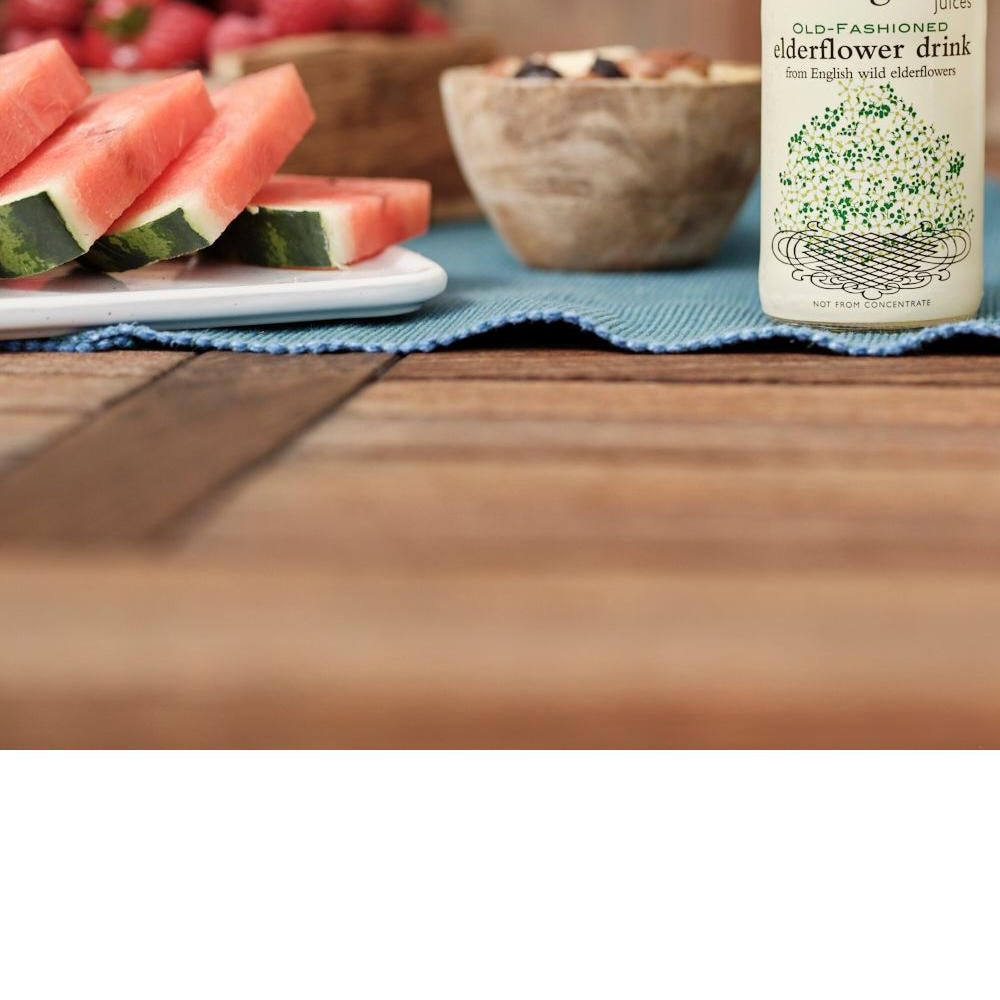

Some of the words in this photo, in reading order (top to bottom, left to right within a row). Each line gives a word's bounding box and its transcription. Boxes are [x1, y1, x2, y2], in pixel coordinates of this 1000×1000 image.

[792, 22, 949, 35] OLD-FASHIONED
[773, 37, 905, 60] elderflower
[916, 34, 972, 59] drink
[785, 66, 808, 79] from
[811, 67, 853, 82] English
[858, 66, 886, 79] wild
[890, 65, 957, 79] elderflowers
[813, 300, 831, 308] NOT
[835, 301, 860, 309] FROM
[864, 299, 932, 309] CONCENTRATE
